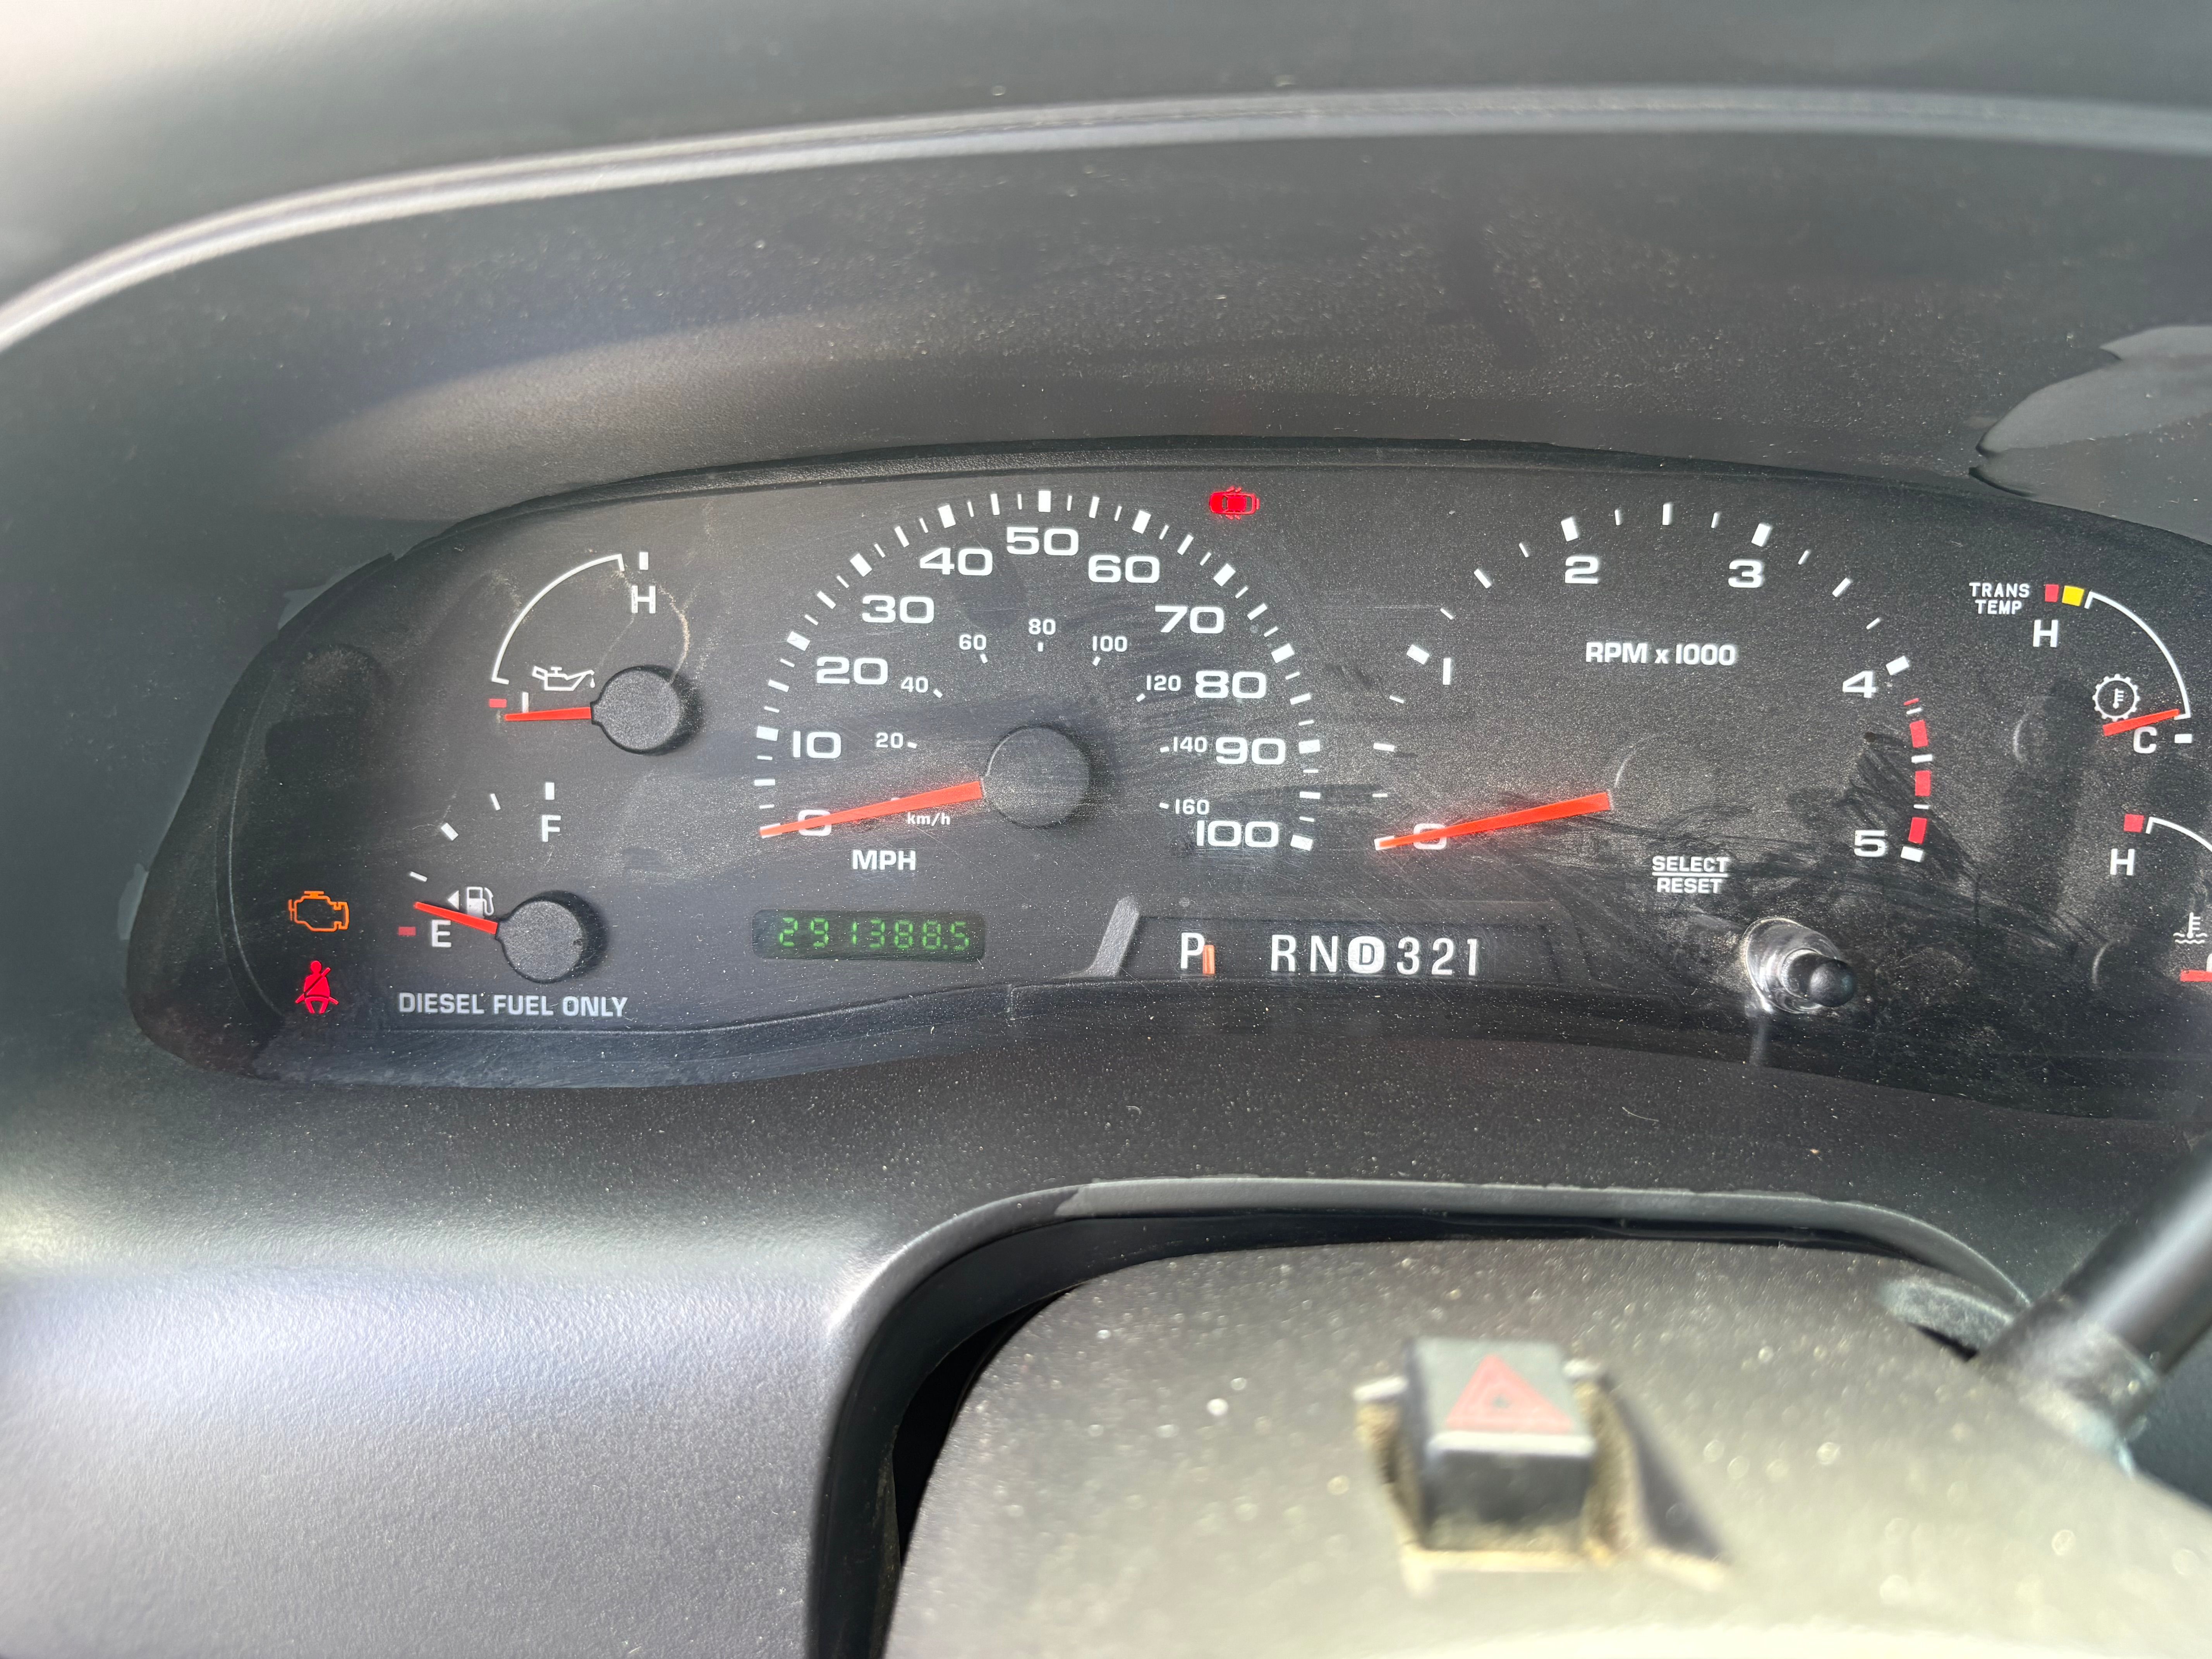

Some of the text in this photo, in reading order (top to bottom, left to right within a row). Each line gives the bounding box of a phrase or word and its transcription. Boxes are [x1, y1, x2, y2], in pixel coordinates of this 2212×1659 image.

[1006, 527, 1079, 556] 50
[920, 547, 993, 576] 40
[1088, 555, 1160, 583] 60
[1565, 555, 1599, 584] 2
[1728, 559, 1764, 588] 3
[632, 586, 656, 613] H
[1969, 582, 2030, 598] TRANS
[862, 595, 934, 624] 30
[1155, 606, 1224, 634] 70
[1975, 600, 2022, 615] TEMP
[1028, 619, 1056, 635] 80
[2033, 620, 2058, 647] H
[959, 635, 987, 651] 60
[1092, 636, 1127, 652] 100
[1586, 642, 1736, 665] RPM x 1000
[816, 656, 888, 685] 20
[1146, 675, 1181, 691] 120
[1443, 658, 1451, 685] 1
[901, 677, 929, 693] 40
[1195, 671, 1266, 699] 80
[1842, 671, 1877, 698] 4
[793, 731, 842, 759] 10
[876, 732, 903, 749] 20
[1173, 737, 1207, 753] 140
[1215, 737, 1286, 765] 90
[2133, 726, 2157, 754] C
[907, 812, 951, 825] km/h
[1175, 799, 1210, 815] 160
[542, 815, 561, 842] F
[1196, 820, 1279, 848] 100
[1413, 823, 1447, 850] 0
[1854, 830, 1887, 857] 5
[852, 850, 916, 871] MPH
[1652, 856, 1730, 872] SELECT
[2110, 848, 2135, 876] H
[1656, 878, 1723, 893] RESET
[431, 920, 452, 947] E
[1180, 933, 1205, 970] P
[1271, 934, 1297, 972] R
[1310, 936, 1338, 973] N
[1396, 937, 1420, 975] 3
[1431, 938, 1454, 975] 2
[1467, 939, 1478, 975] 1
[399, 993, 628, 1017] DIESEL FUEL ONLY
